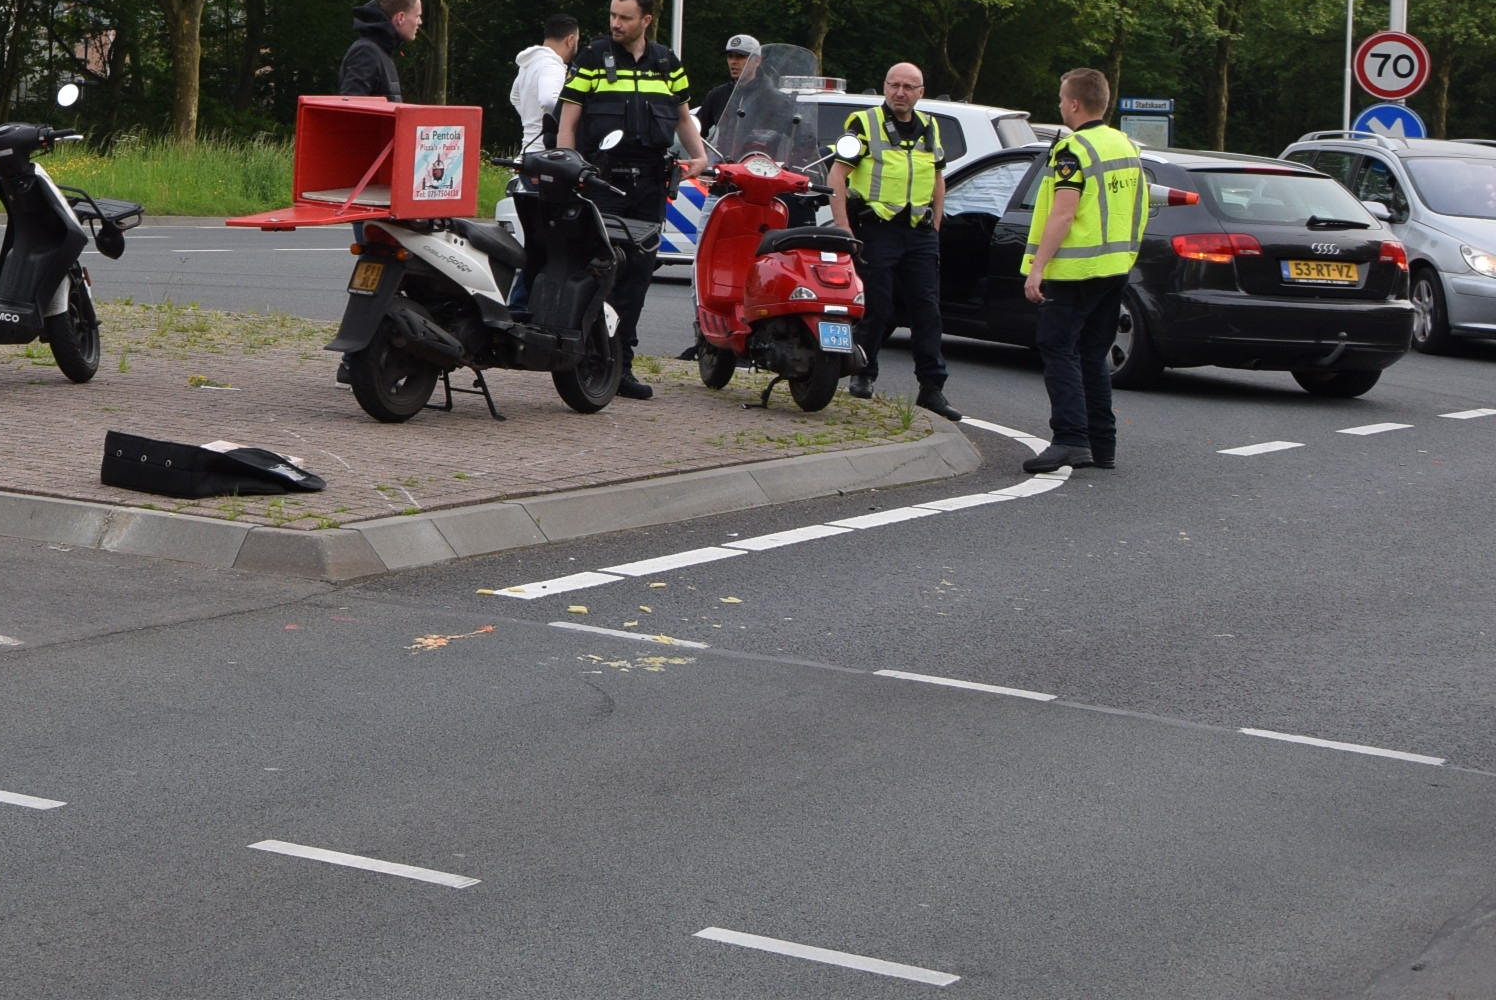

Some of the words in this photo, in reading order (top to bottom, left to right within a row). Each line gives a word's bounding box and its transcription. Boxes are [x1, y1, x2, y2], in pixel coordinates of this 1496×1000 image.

[1370, 52, 1415, 79] 70
[1135, 100, 1167, 109] Stadskaart
[420, 130, 430, 141] La
[432, 129, 461, 141] Pentola
[420, 143, 438, 151] Pizza's
[442, 143, 460, 151] Pasta's
[1294, 262, 1353, 279] 53-RT-VZ
[829, 325, 848, 336] F79
[830, 336, 849, 347] 9JR
